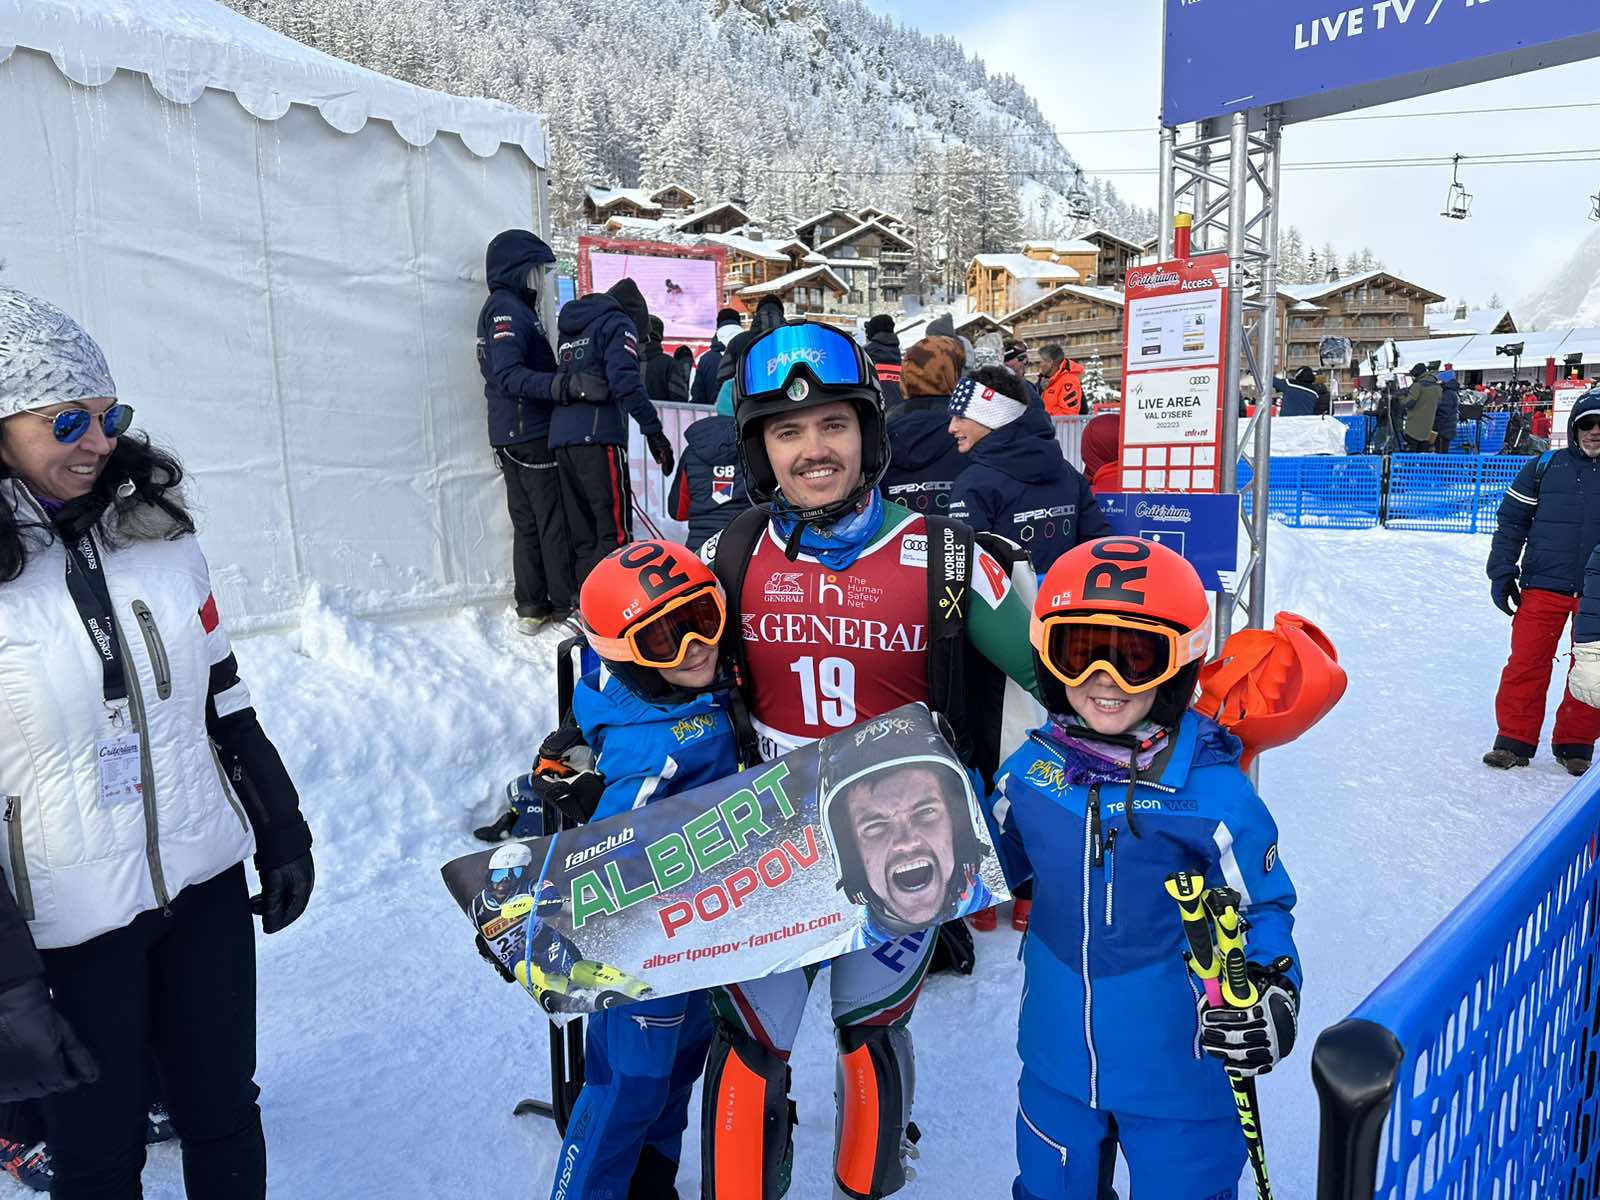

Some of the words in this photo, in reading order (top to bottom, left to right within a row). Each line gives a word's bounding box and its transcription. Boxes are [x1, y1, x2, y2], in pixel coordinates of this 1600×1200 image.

[1294, 7, 1364, 50] LIVE
[1372, 0, 1414, 30] TV
[1181, 278, 1214, 290] Access
[1138, 398, 1164, 410] LIVE
[1166, 395, 1201, 408] AREA
[712, 464, 736, 479] GB
[943, 527, 955, 581] WORLDCUP
[955, 544, 966, 582] REBELS
[763, 594, 805, 604] GENERALI
[847, 575, 867, 585] The
[847, 583, 884, 595] Human
[847, 591, 880, 603] Safety
[847, 599, 865, 609] Net
[87, 617, 114, 661] LONGINES
[759, 612, 929, 653] GENERAL
[790, 655, 857, 728] 19
[1106, 799, 1161, 814] Teson
[565, 826, 635, 868] fanclub
[570, 760, 796, 930] ALBERT
[657, 824, 821, 940] POPOV
[642, 911, 843, 970] albertpopov-fanclub.com
[555, 1143, 581, 1200] enson
